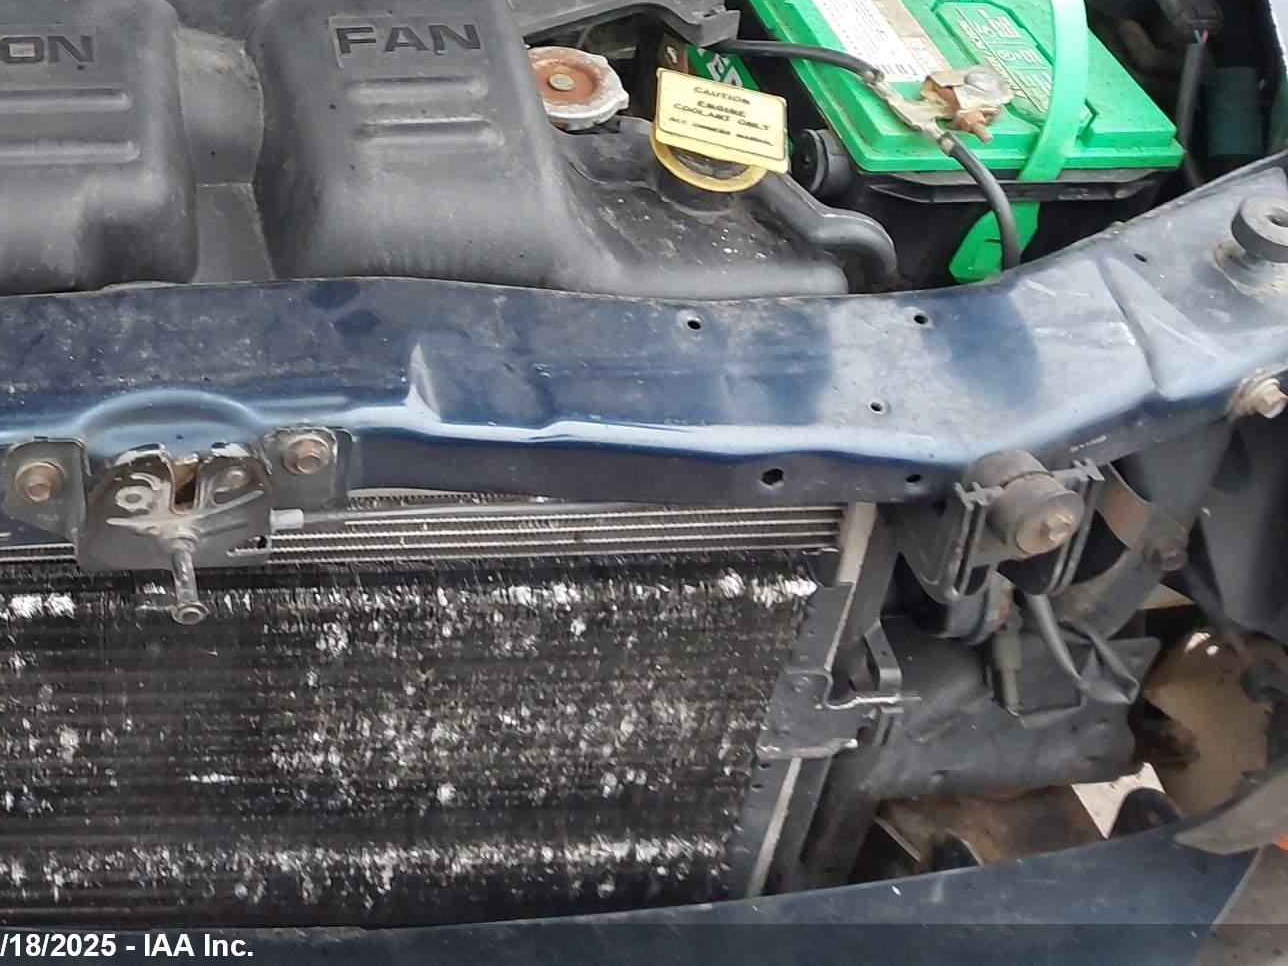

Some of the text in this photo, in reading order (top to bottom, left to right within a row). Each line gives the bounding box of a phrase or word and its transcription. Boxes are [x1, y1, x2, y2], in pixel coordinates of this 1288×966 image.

[336, 24, 482, 54] FAN
[694, 86, 751, 105] CAUTION
[673, 103, 771, 131] COOLANT ONLY
[697, 100, 747, 118] ENGINE
